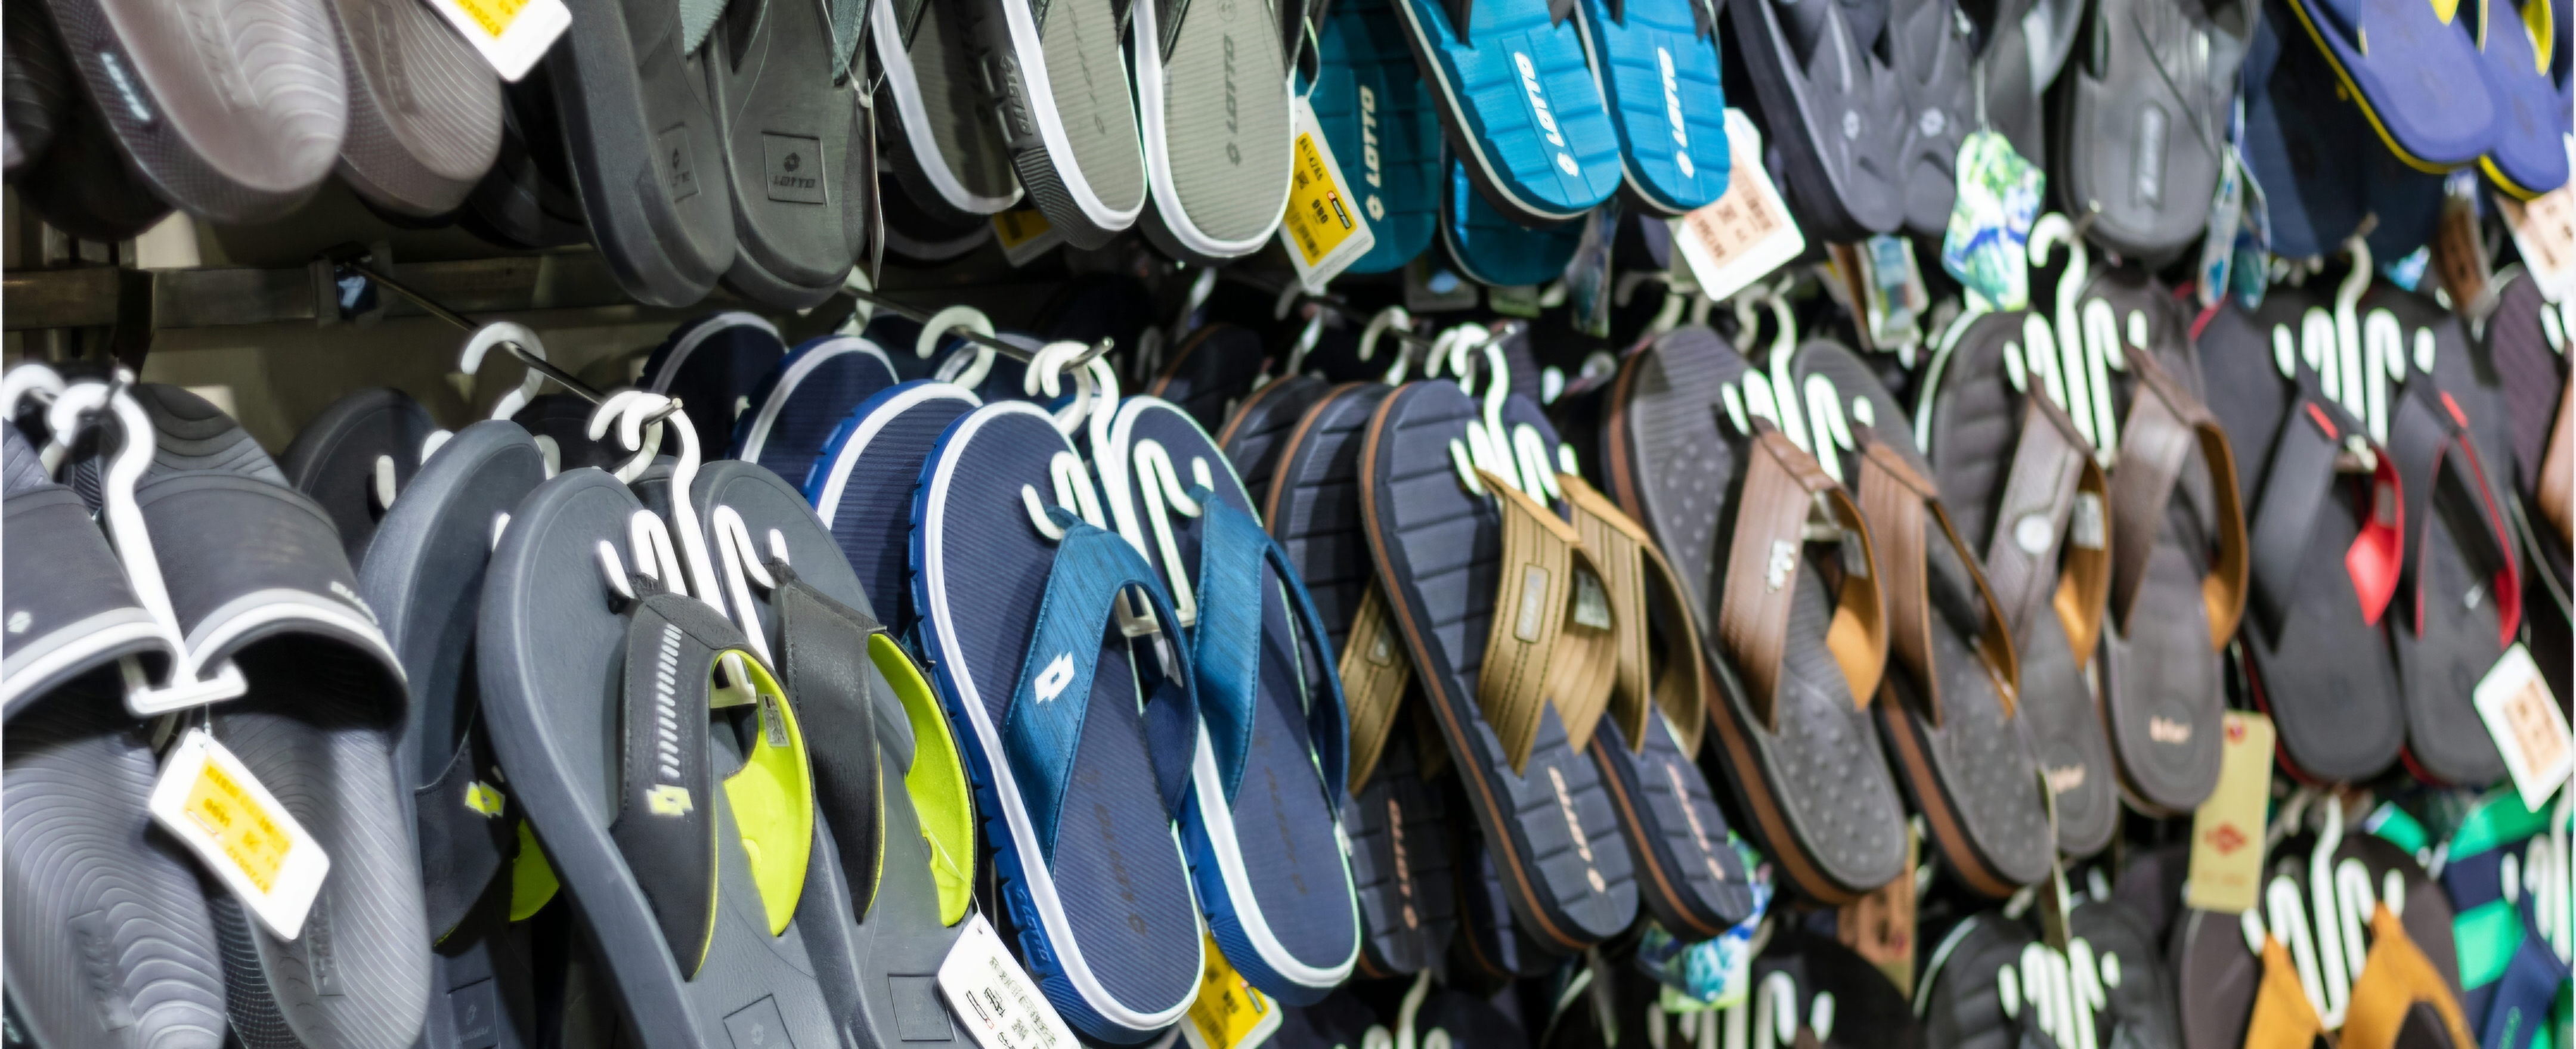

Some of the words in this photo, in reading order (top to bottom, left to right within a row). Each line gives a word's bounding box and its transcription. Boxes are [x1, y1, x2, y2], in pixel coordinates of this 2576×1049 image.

[1224, 33, 1238, 135] LOTTO
[1513, 50, 1565, 148] LOTTO
[1657, 46, 1688, 148] LOTTO
[773, 175, 816, 188] LOTTO
[1359, 85, 1382, 188] LOTTO
